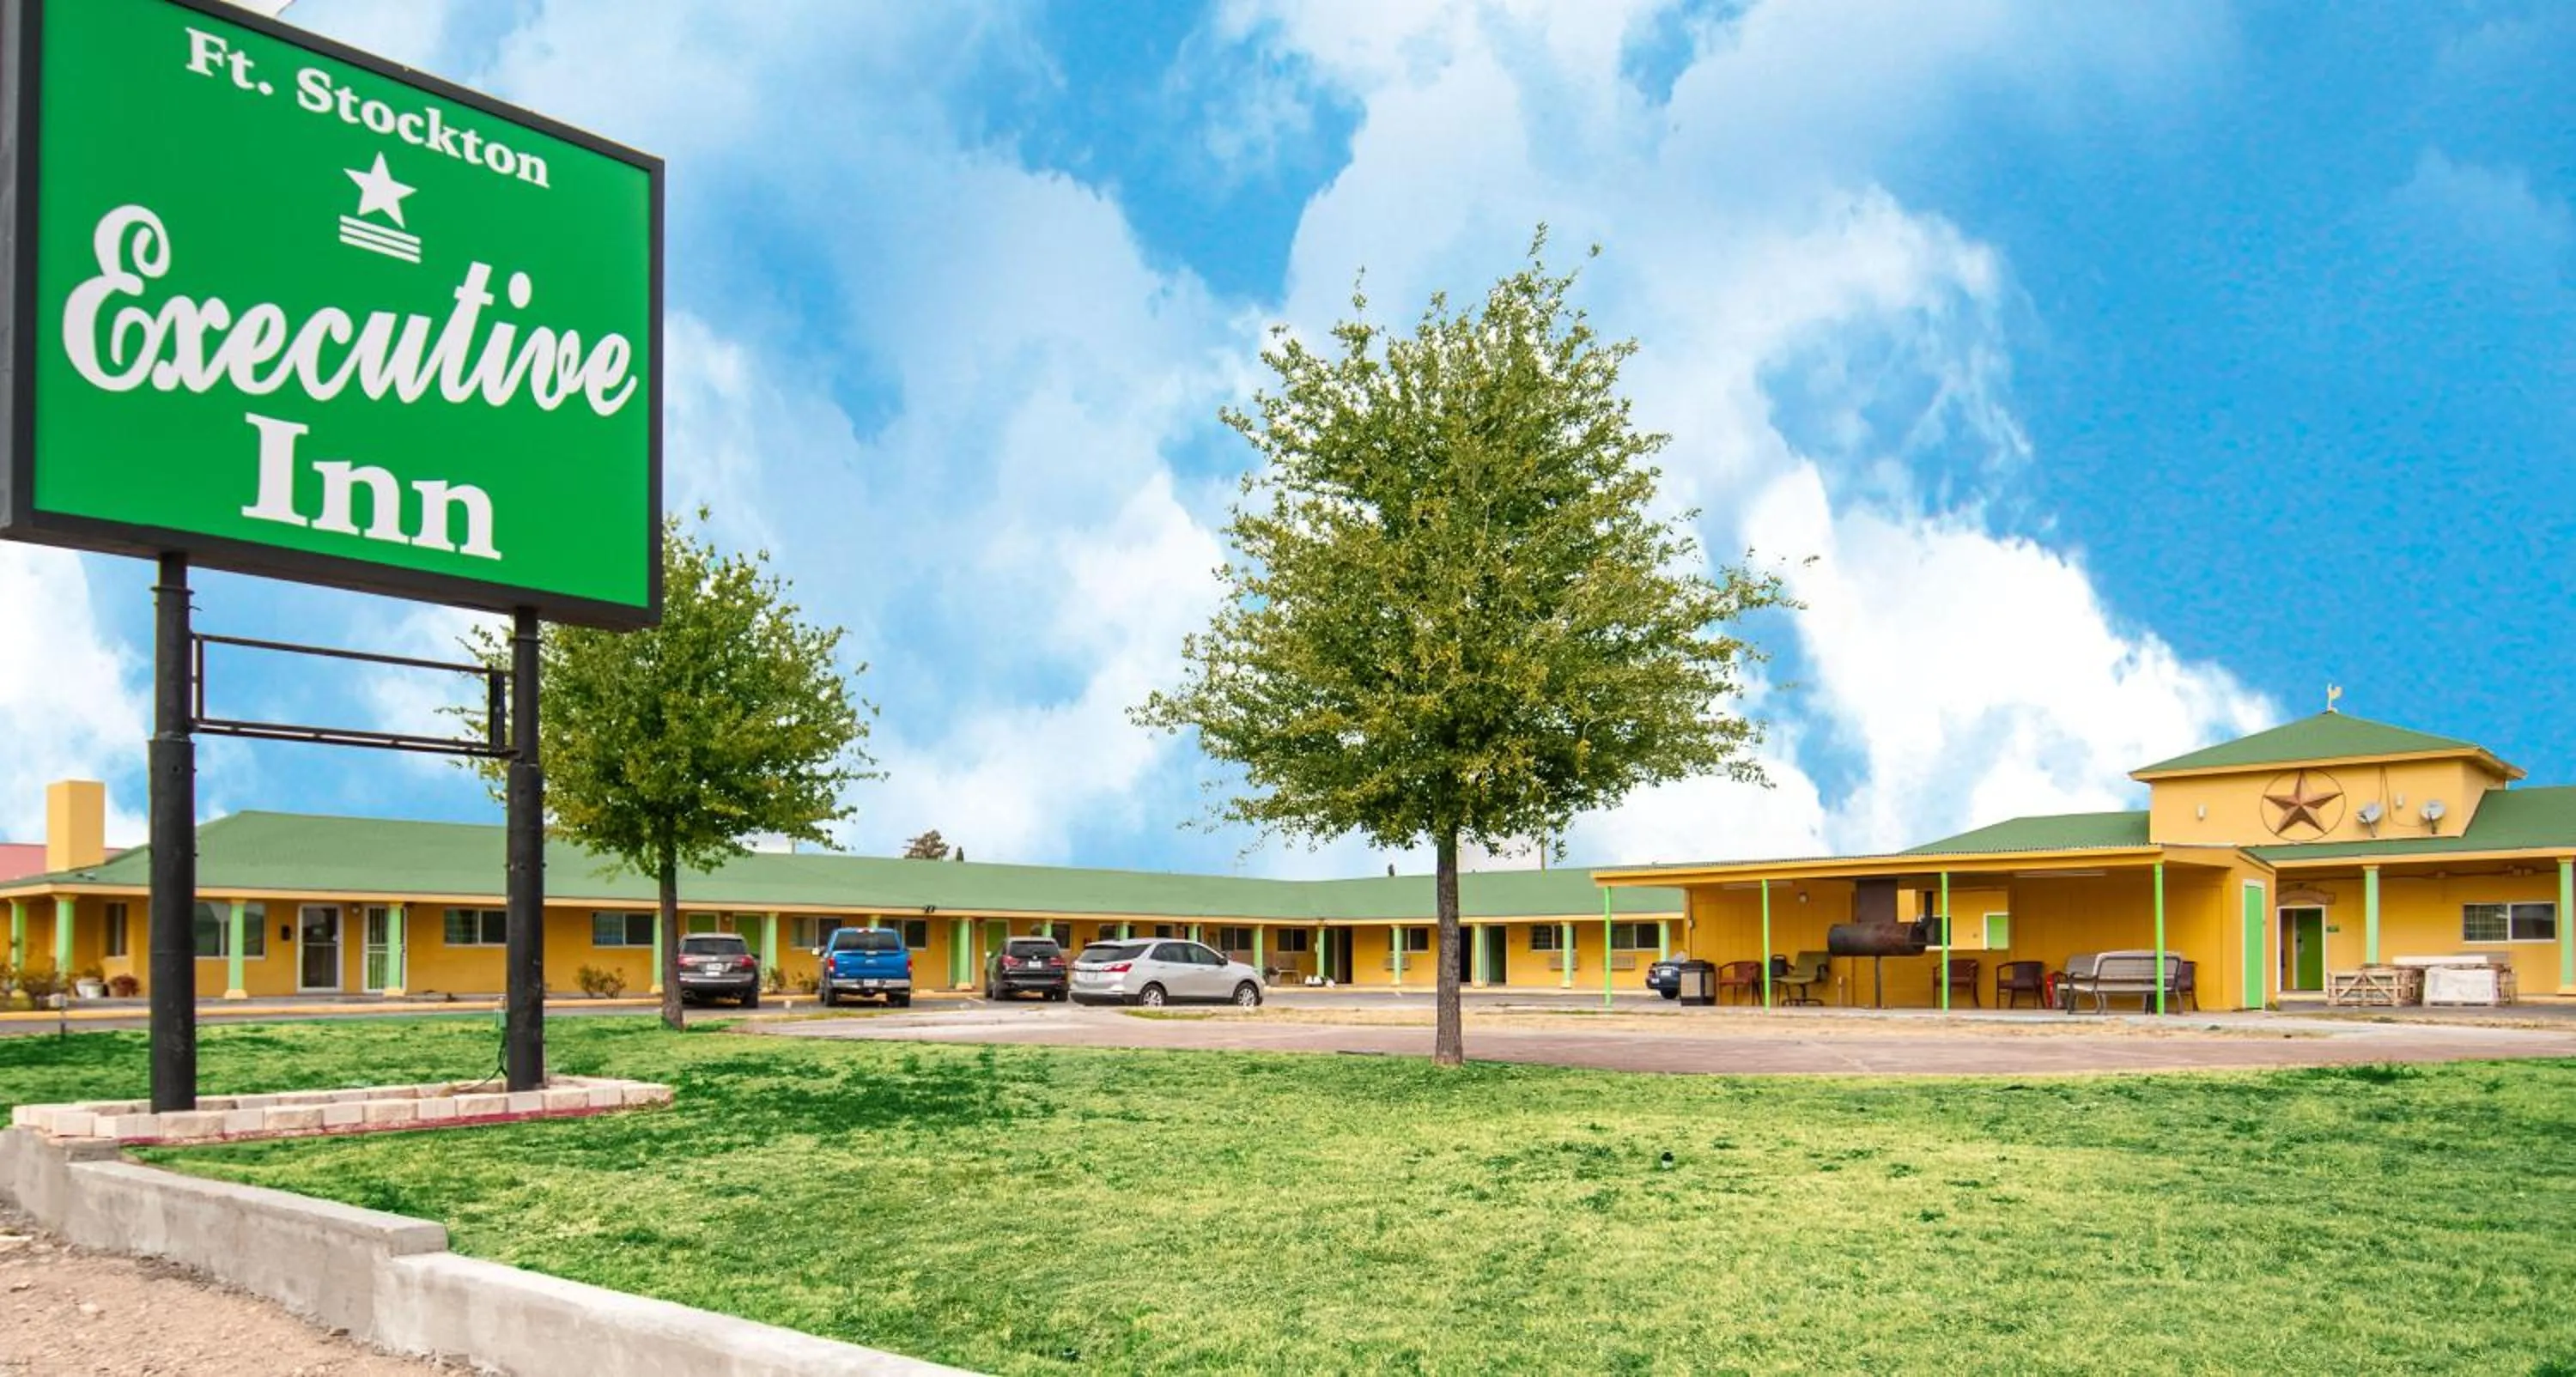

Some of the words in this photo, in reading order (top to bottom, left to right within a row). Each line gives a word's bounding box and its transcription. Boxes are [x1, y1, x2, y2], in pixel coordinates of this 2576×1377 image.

[186, 27, 273, 94] Ft.
[297, 69, 550, 187] Stockton
[63, 205, 637, 416] Executive
[242, 413, 501, 560] Inn
